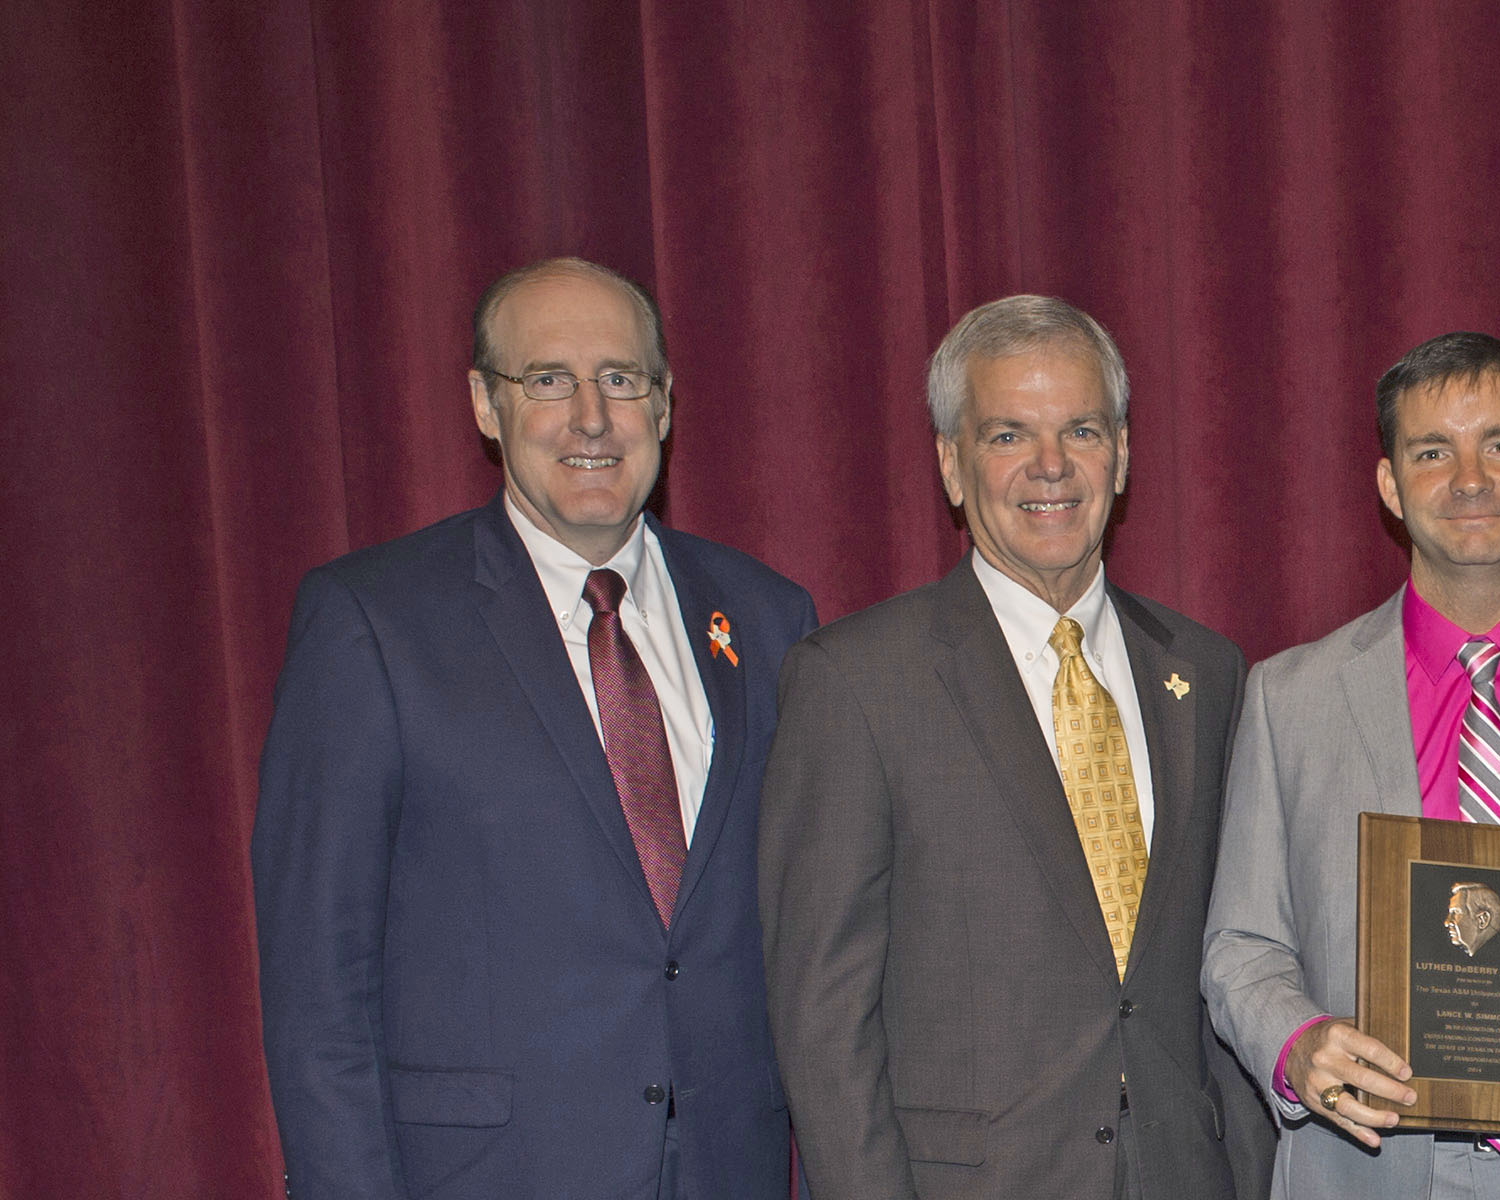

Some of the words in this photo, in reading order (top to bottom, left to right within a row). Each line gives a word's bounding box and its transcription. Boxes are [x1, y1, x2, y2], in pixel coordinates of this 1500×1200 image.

[1416, 962, 1453, 972] LUTHER
[1455, 965, 1498, 975] DeBERRY
[1430, 985, 1451, 994] Texas
[1436, 1010, 1462, 1019] LANCE
